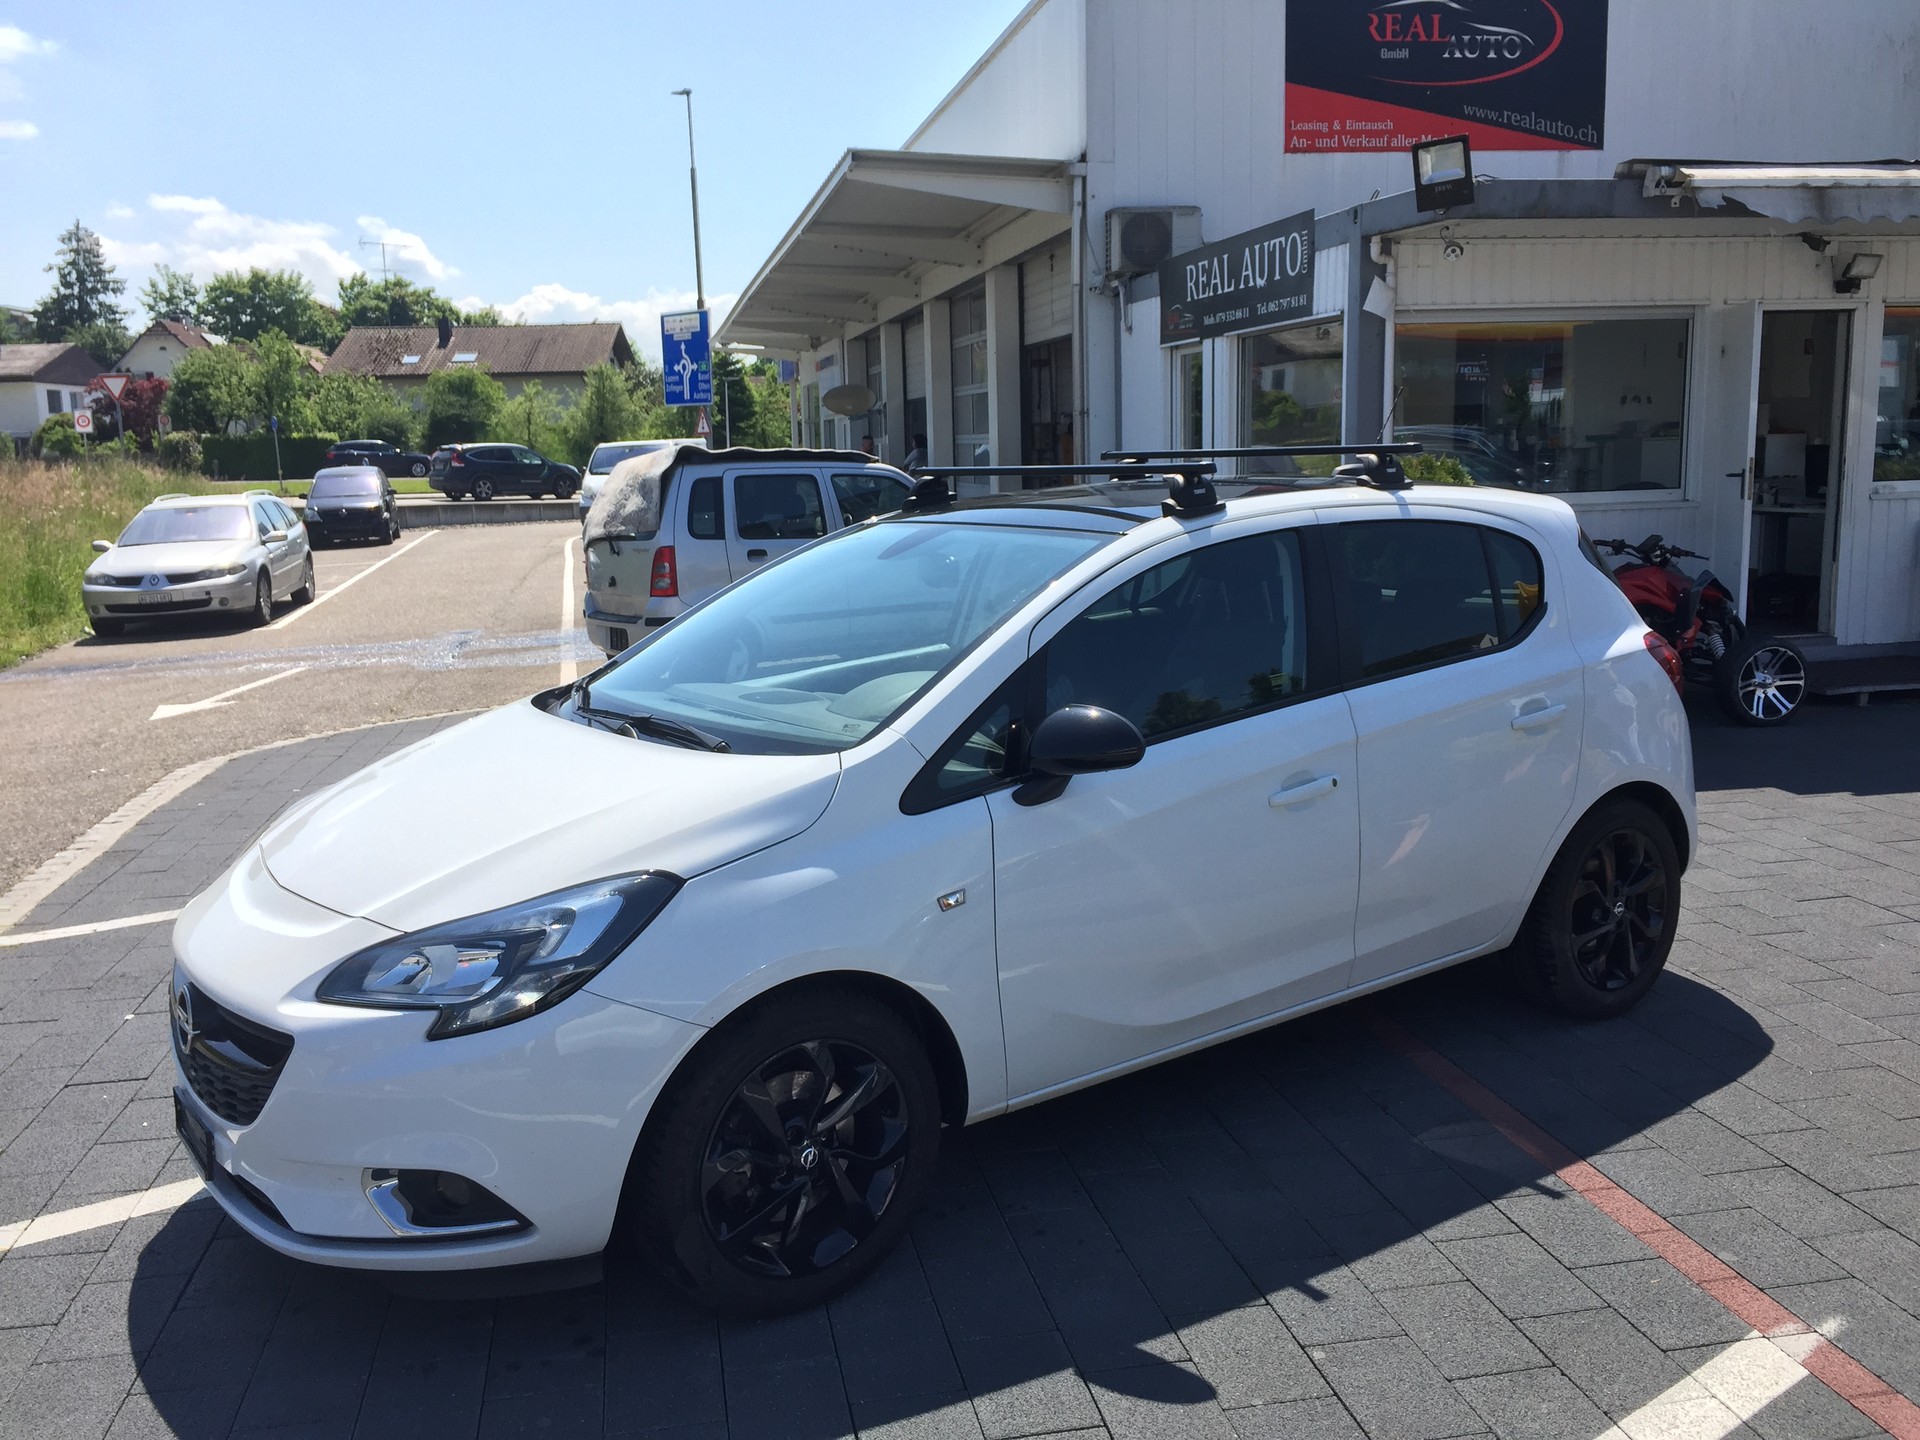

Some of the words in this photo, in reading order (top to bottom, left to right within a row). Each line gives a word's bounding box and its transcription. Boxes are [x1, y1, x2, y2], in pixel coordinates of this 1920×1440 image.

[1368, 13, 1451, 42] REAL
[1442, 35, 1522, 59] AUTO
[1380, 48, 1409, 59] GmbH
[1291, 119, 1329, 132] Leasing
[1333, 121, 1341, 130] &
[1346, 119, 1394, 130] Eintausch
[1463, 104, 1598, 144] www.realauto.ch
[1290, 136, 1312, 148] An-
[1315, 136, 1338, 148] und
[1341, 134, 1389, 147] Verkauf
[1391, 134, 1418, 147] aller
[1186, 253, 1235, 302] REAL
[1239, 232, 1301, 289] AUTO
